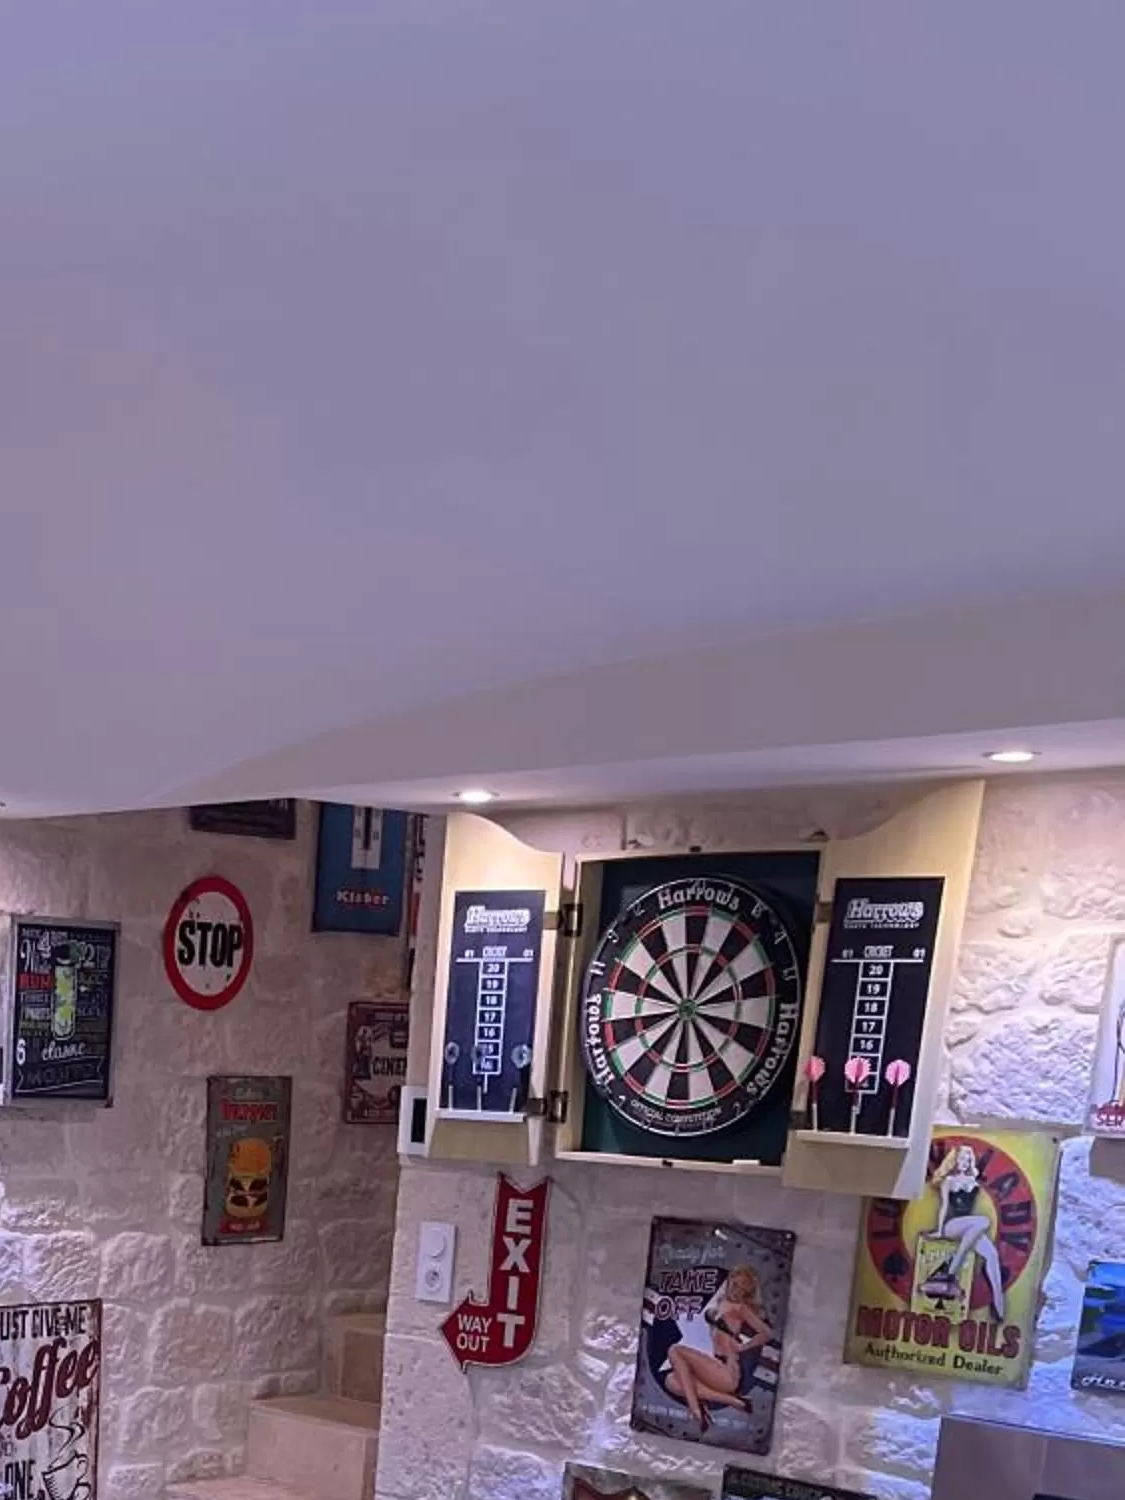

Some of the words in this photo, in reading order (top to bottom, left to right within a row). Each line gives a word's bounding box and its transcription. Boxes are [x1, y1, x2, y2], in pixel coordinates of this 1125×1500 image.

[658, 887, 740, 911] Harrows
[846, 898, 924, 922] Harrows
[177, 920, 243, 967] STOP
[487, 963, 500, 973] 20
[869, 964, 884, 975] 20
[867, 983, 880, 994] 19
[486, 995, 497, 1005] 18
[864, 1002, 877, 1012] 18
[484, 1011, 496, 1021] 17
[483, 1027, 495, 1037] 16
[862, 1020, 876, 1032] 17
[860, 1039, 874, 1050] 16
[497, 1199, 534, 1348] EXIT
[658, 1269, 719, 1294] TAKE
[655, 1295, 704, 1321] OFF
[32, 1306, 61, 1338] GIVE
[457, 1314, 492, 1333] WAY
[856, 1306, 951, 1348] MOTOR
[958, 1319, 1022, 1358] OILS
[456, 1333, 491, 1352] OUT
[864, 1342, 946, 1367] Authorized
[953, 1355, 1003, 1375] Dealer
